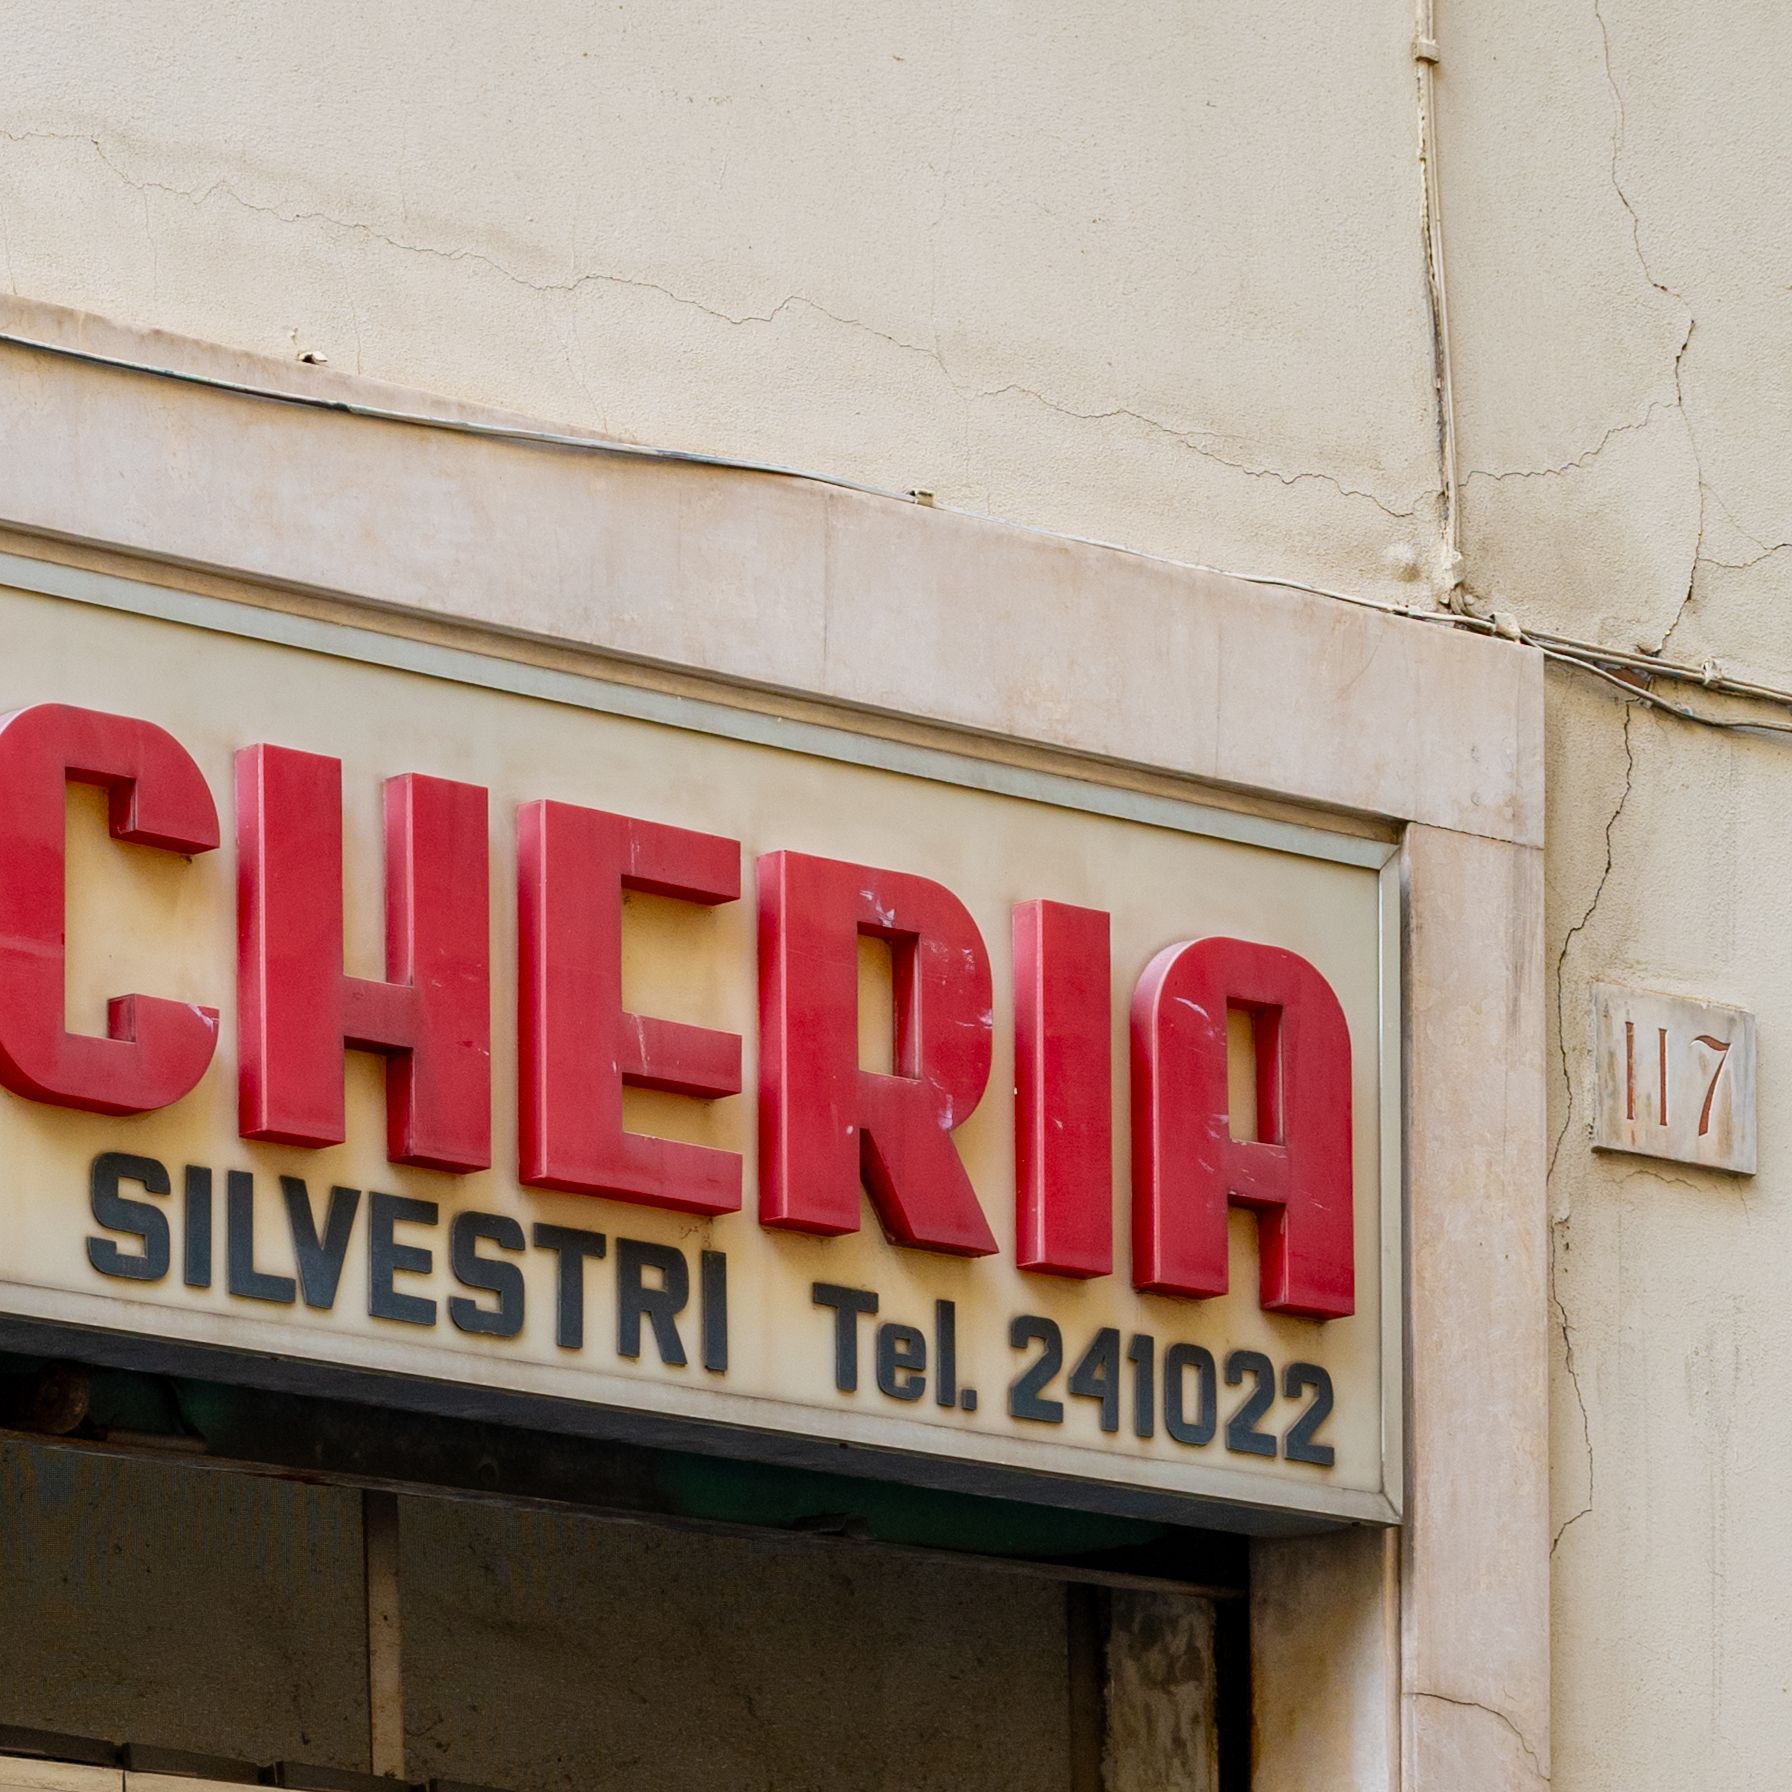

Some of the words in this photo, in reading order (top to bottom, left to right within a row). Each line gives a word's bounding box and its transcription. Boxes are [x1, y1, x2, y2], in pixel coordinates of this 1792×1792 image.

[1625, 1021, 1733, 1136] 117
[87, 1150, 727, 1373] SILVESTRI
[812, 1282, 977, 1414] Tel.
[1007, 1316, 1336, 1467] 241022
